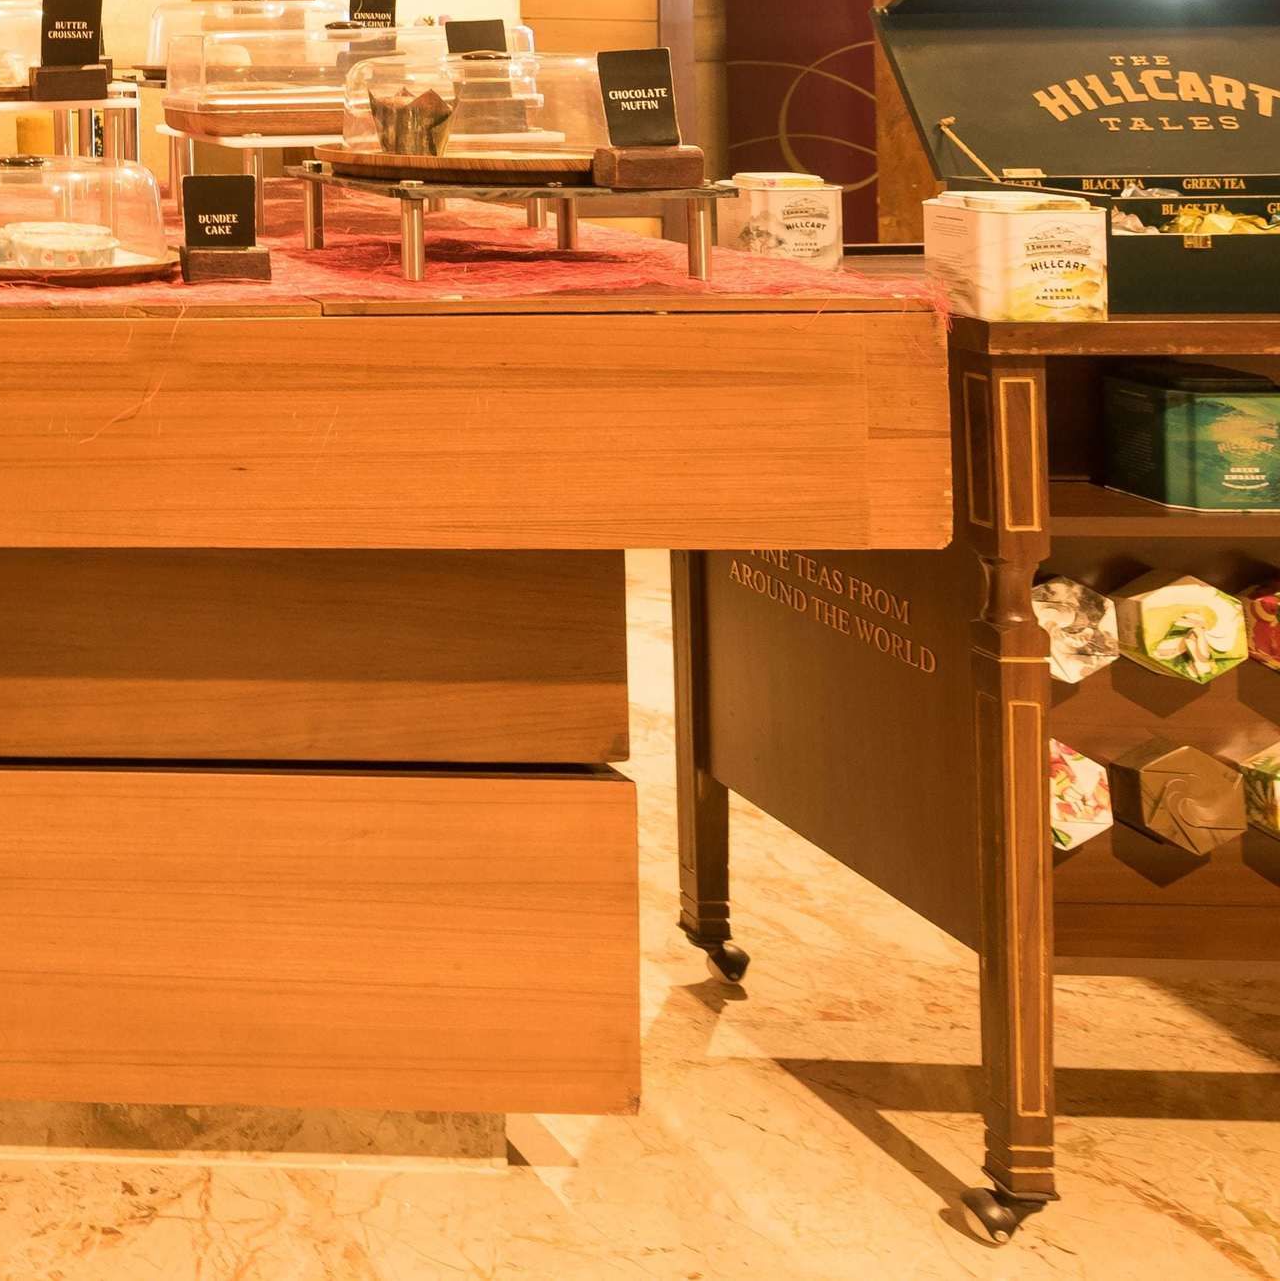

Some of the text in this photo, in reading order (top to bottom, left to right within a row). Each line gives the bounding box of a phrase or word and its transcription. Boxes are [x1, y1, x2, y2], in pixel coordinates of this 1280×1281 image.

[55, 21, 88, 29] BUTTER
[48, 30, 94, 39] CROISSANT
[1109, 55, 1171, 66] THE
[608, 88, 669, 100] CHOCOLATE
[1032, 69, 1280, 122] HILLCART
[620, 100, 659, 111] MUFFIN
[1099, 115, 1240, 131] TALES
[1082, 178, 1144, 191] BLACK TEA
[1182, 178, 1246, 190] GREEN TEA
[198, 214, 239, 224] DUNDEE
[205, 225, 232, 235] CAKE
[785, 221, 827, 231] HILLCART
[1031, 259, 1087, 272] HILLCART
[795, 553, 844, 595] TEAS
[848, 576, 910, 626] FROM
[729, 560, 936, 674] AROUND THE WORLD
